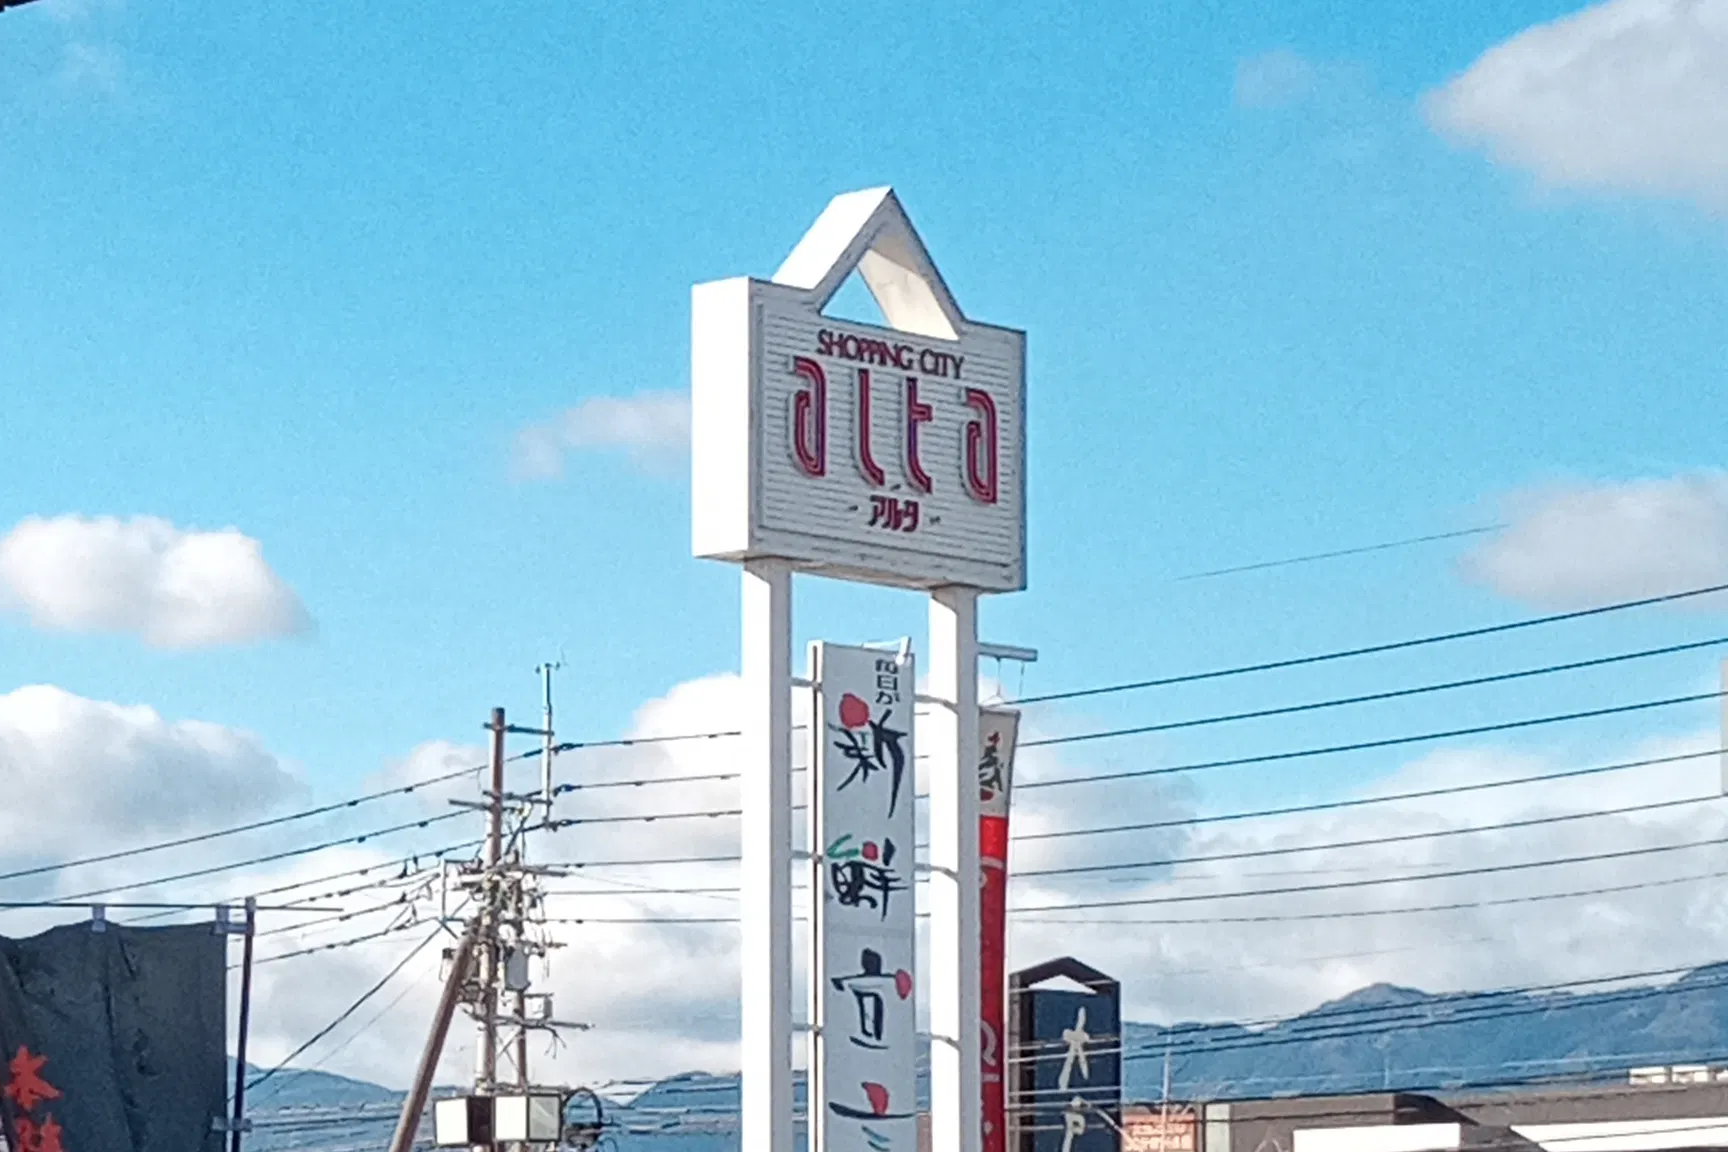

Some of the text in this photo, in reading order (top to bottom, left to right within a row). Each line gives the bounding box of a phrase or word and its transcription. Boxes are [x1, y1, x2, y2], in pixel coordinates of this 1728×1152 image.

[817, 329, 966, 381] SHOPPING CITY
[790, 355, 998, 505] alta
